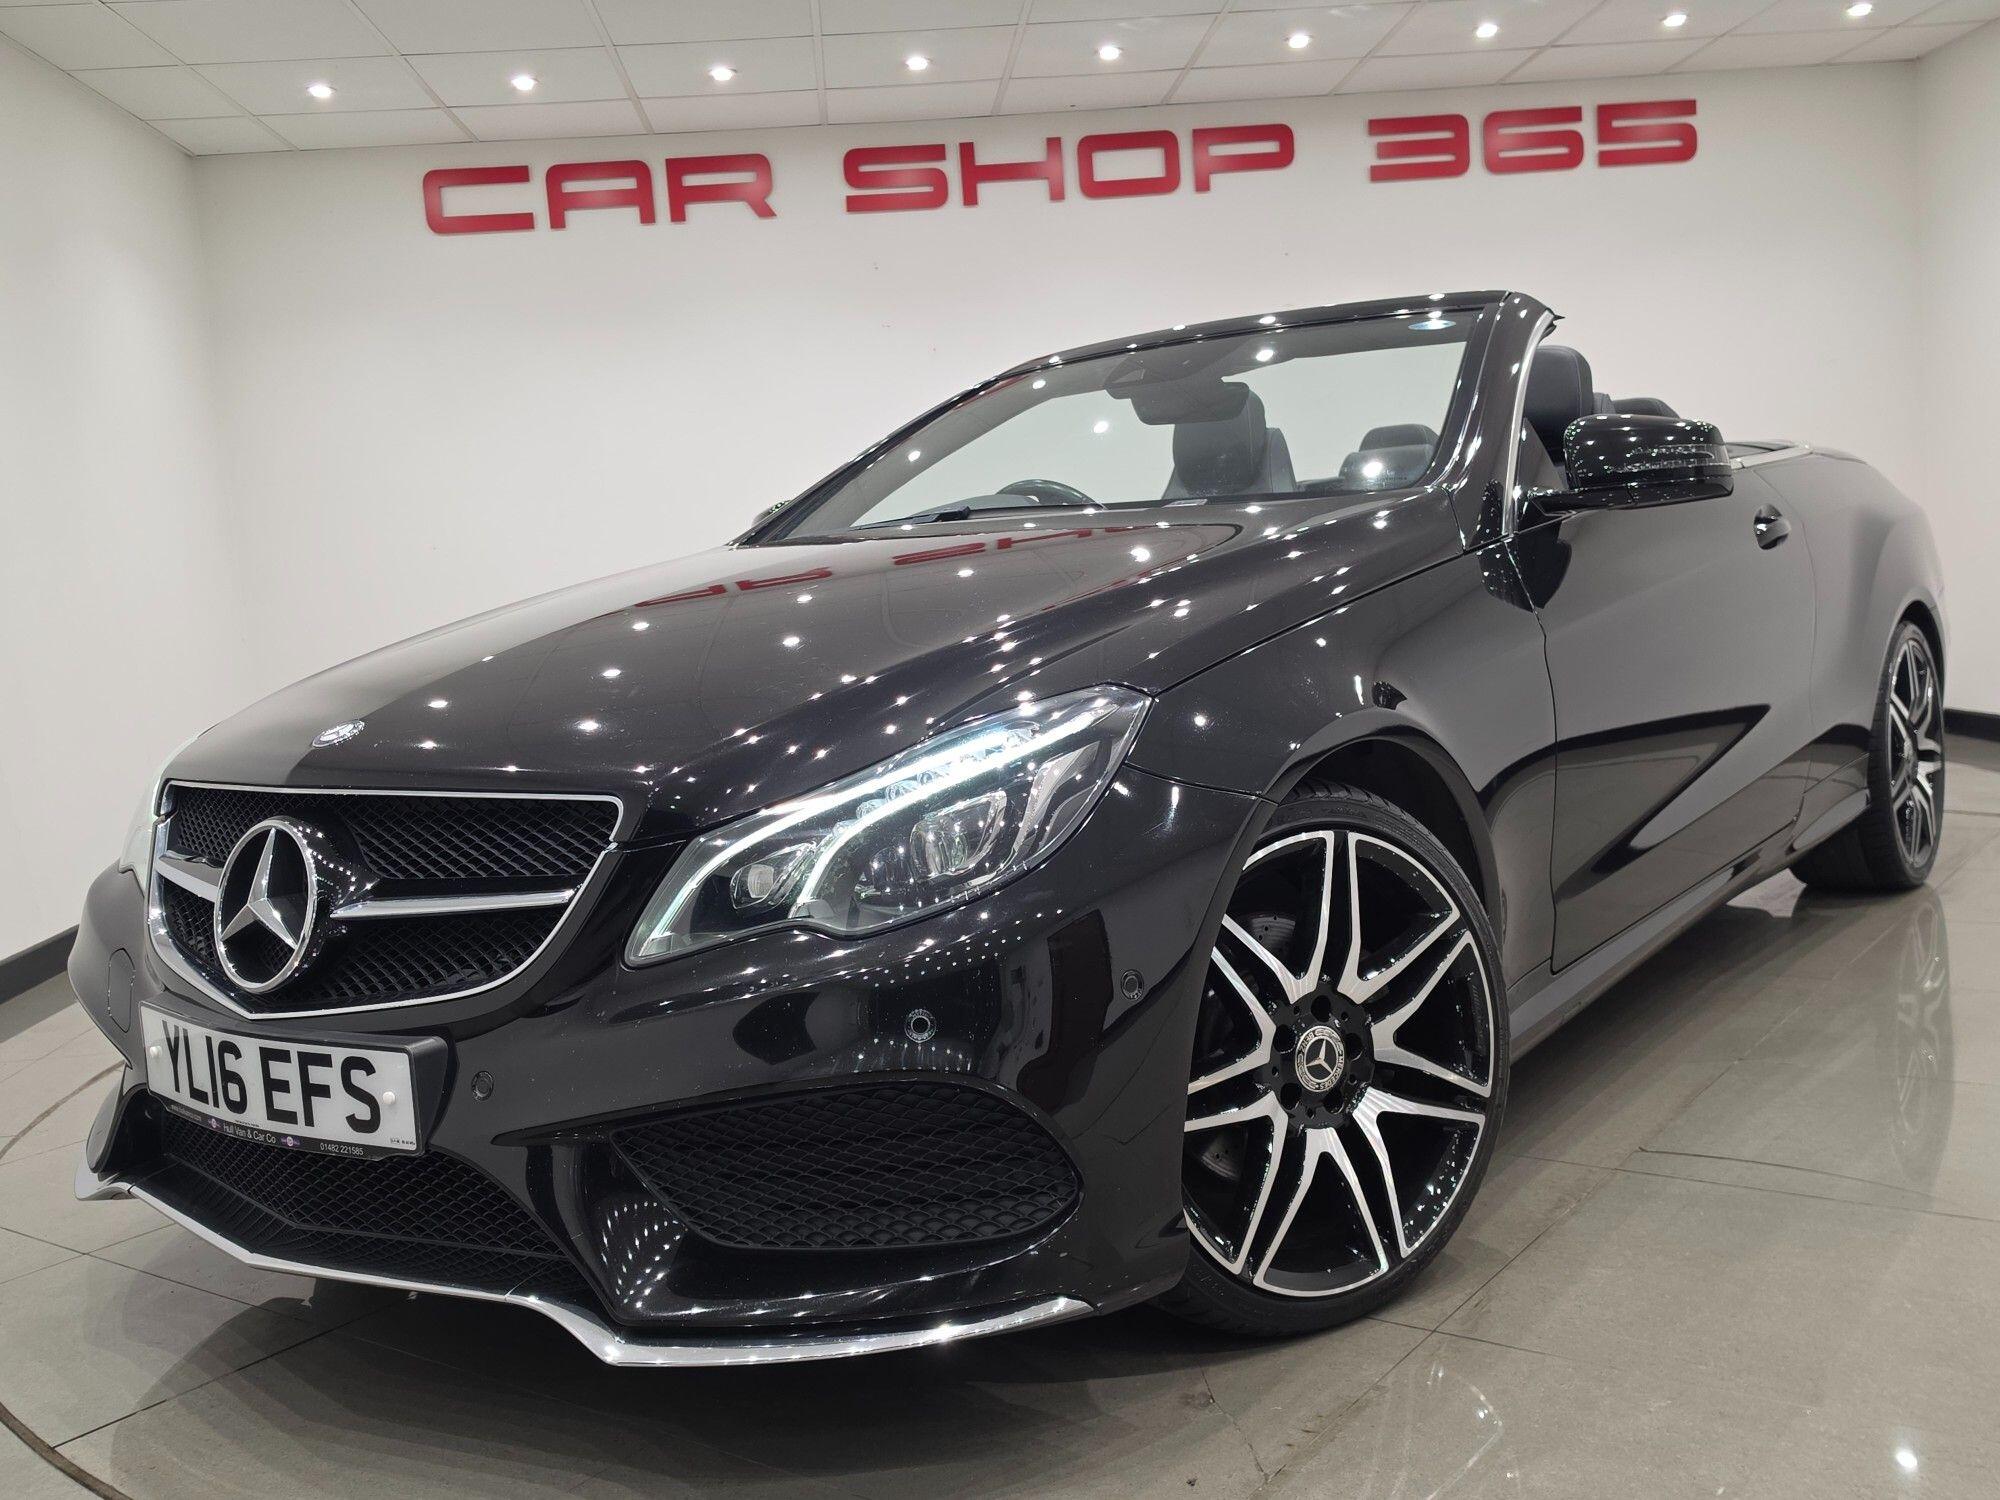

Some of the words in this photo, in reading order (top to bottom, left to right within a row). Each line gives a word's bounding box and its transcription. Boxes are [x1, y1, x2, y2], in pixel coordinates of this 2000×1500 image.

[423, 154, 777, 235] CAR
[843, 124, 1295, 212] SHOP
[1369, 100, 1697, 181] 365
[161, 1020, 248, 1115] YL16
[259, 1046, 381, 1134] EFS
[223, 1123, 234, 1135] Hull
[235, 1126, 246, 1137] Van
[247, 1129, 253, 1139] &
[253, 1131, 265, 1142] Car
[266, 1133, 276, 1144] Co
[320, 1142, 339, 1153] 01482
[340, 1144, 364, 1156] 221585
